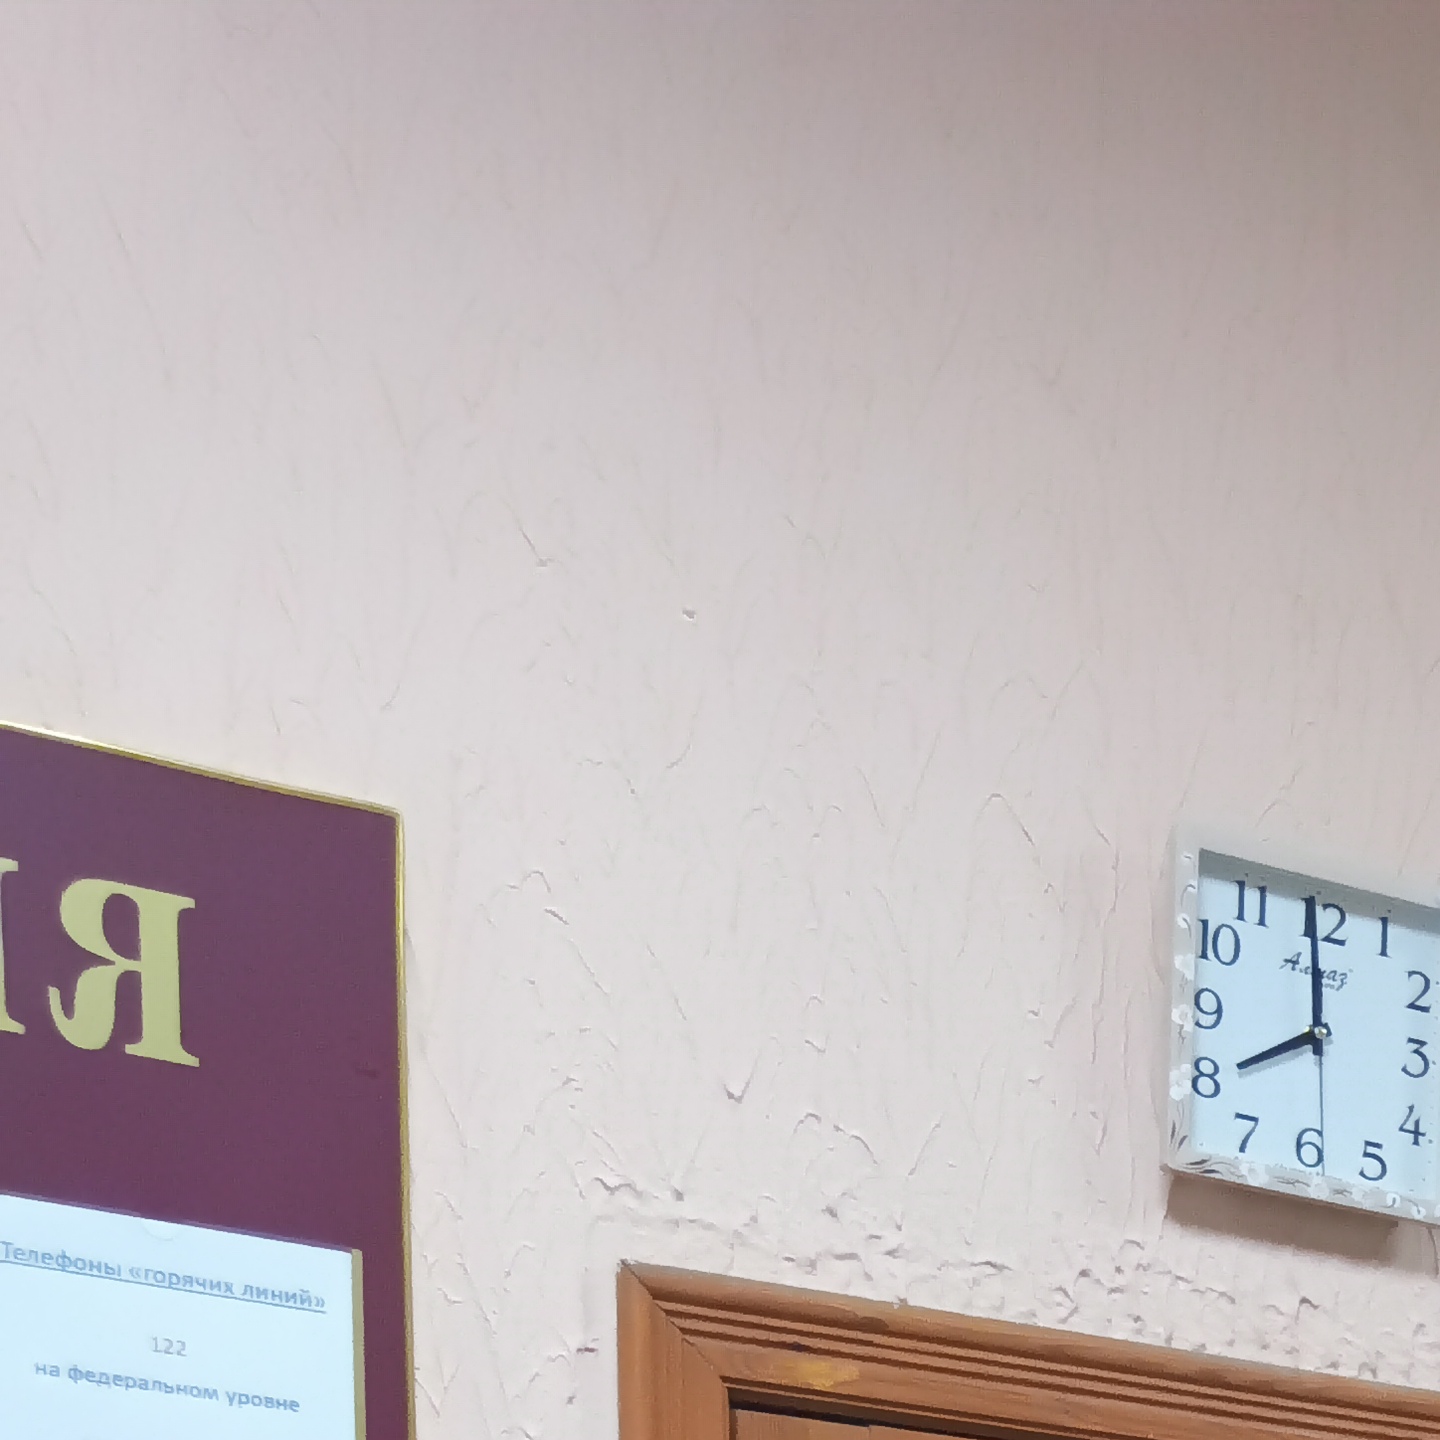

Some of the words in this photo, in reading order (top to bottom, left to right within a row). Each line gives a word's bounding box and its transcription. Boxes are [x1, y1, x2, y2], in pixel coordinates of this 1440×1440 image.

[1234, 881, 1269, 927] 11
[1198, 919, 1240, 966] 10
[1377, 916, 1392, 958] 1
[1194, 987, 1222, 1030] 9
[1406, 971, 1431, 1013] 2
[1192, 1057, 1220, 1098] 8
[1401, 1037, 1430, 1078] 3
[1234, 1112, 1259, 1153] 7
[1399, 1105, 1426, 1147] 4
[1296, 1128, 1324, 1168] 6
[1359, 1141, 1387, 1181] 5
[0, 1240, 121, 1278] Телефоны
[128, 1266, 235, 1296] «горячих
[240, 1284, 326, 1309] линий»
[151, 1336, 187, 1357] 122
[35, 1362, 60, 1378] на
[68, 1364, 219, 1401] федеральном
[225, 1390, 300, 1413] уровне
